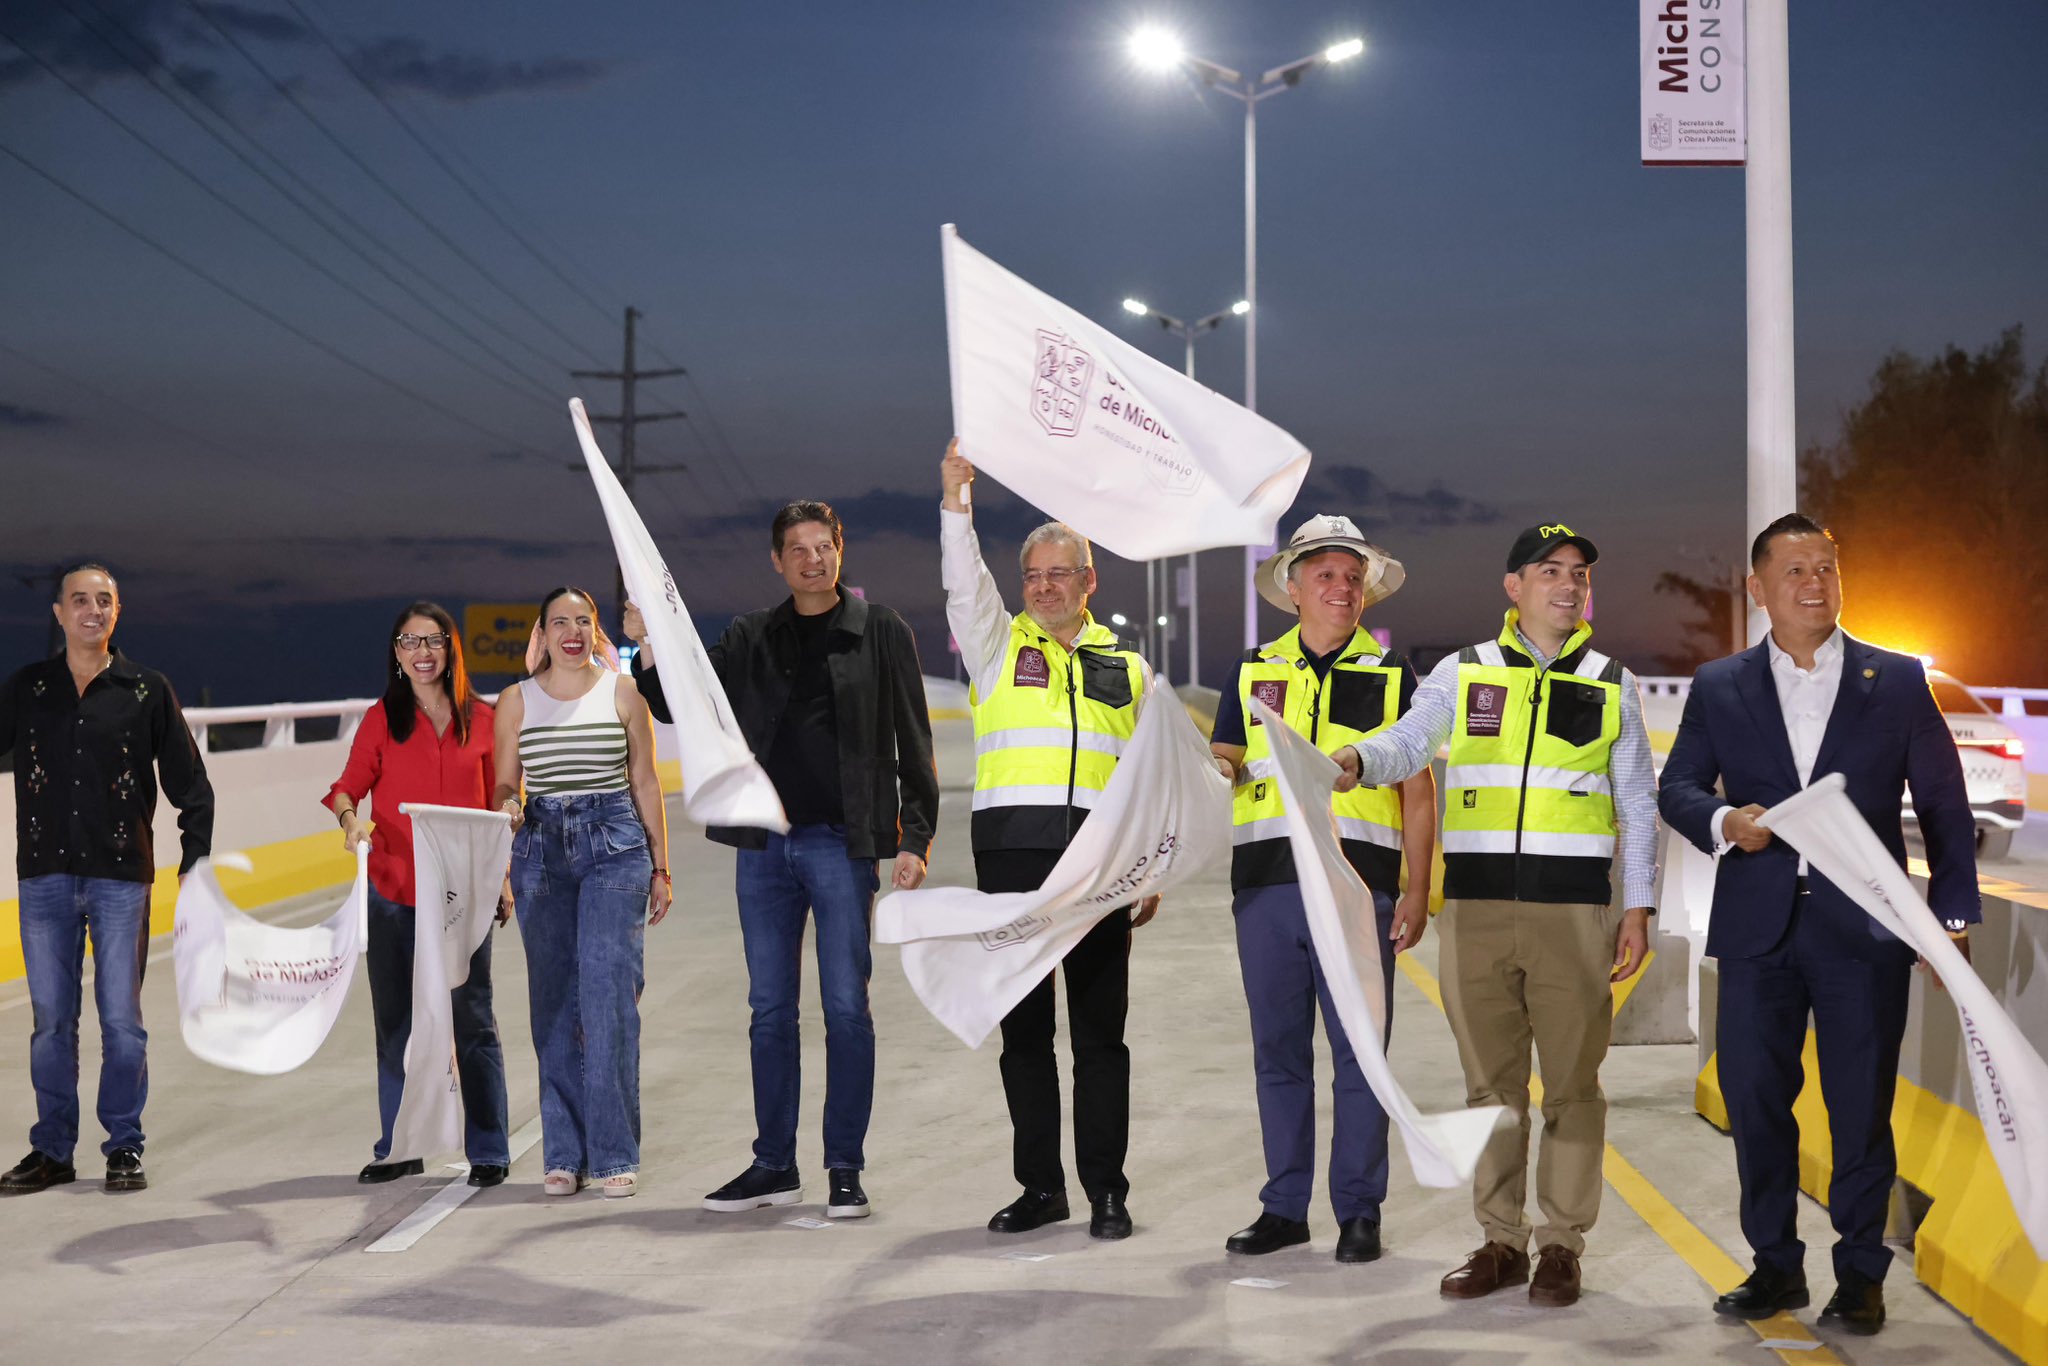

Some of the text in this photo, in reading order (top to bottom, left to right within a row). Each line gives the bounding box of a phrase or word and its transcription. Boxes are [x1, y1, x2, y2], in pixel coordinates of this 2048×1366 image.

[1657, 0, 1688, 92] Mich
[1099, 393, 1120, 415] de
[1153, 453, 1193, 476] TRABAJO
